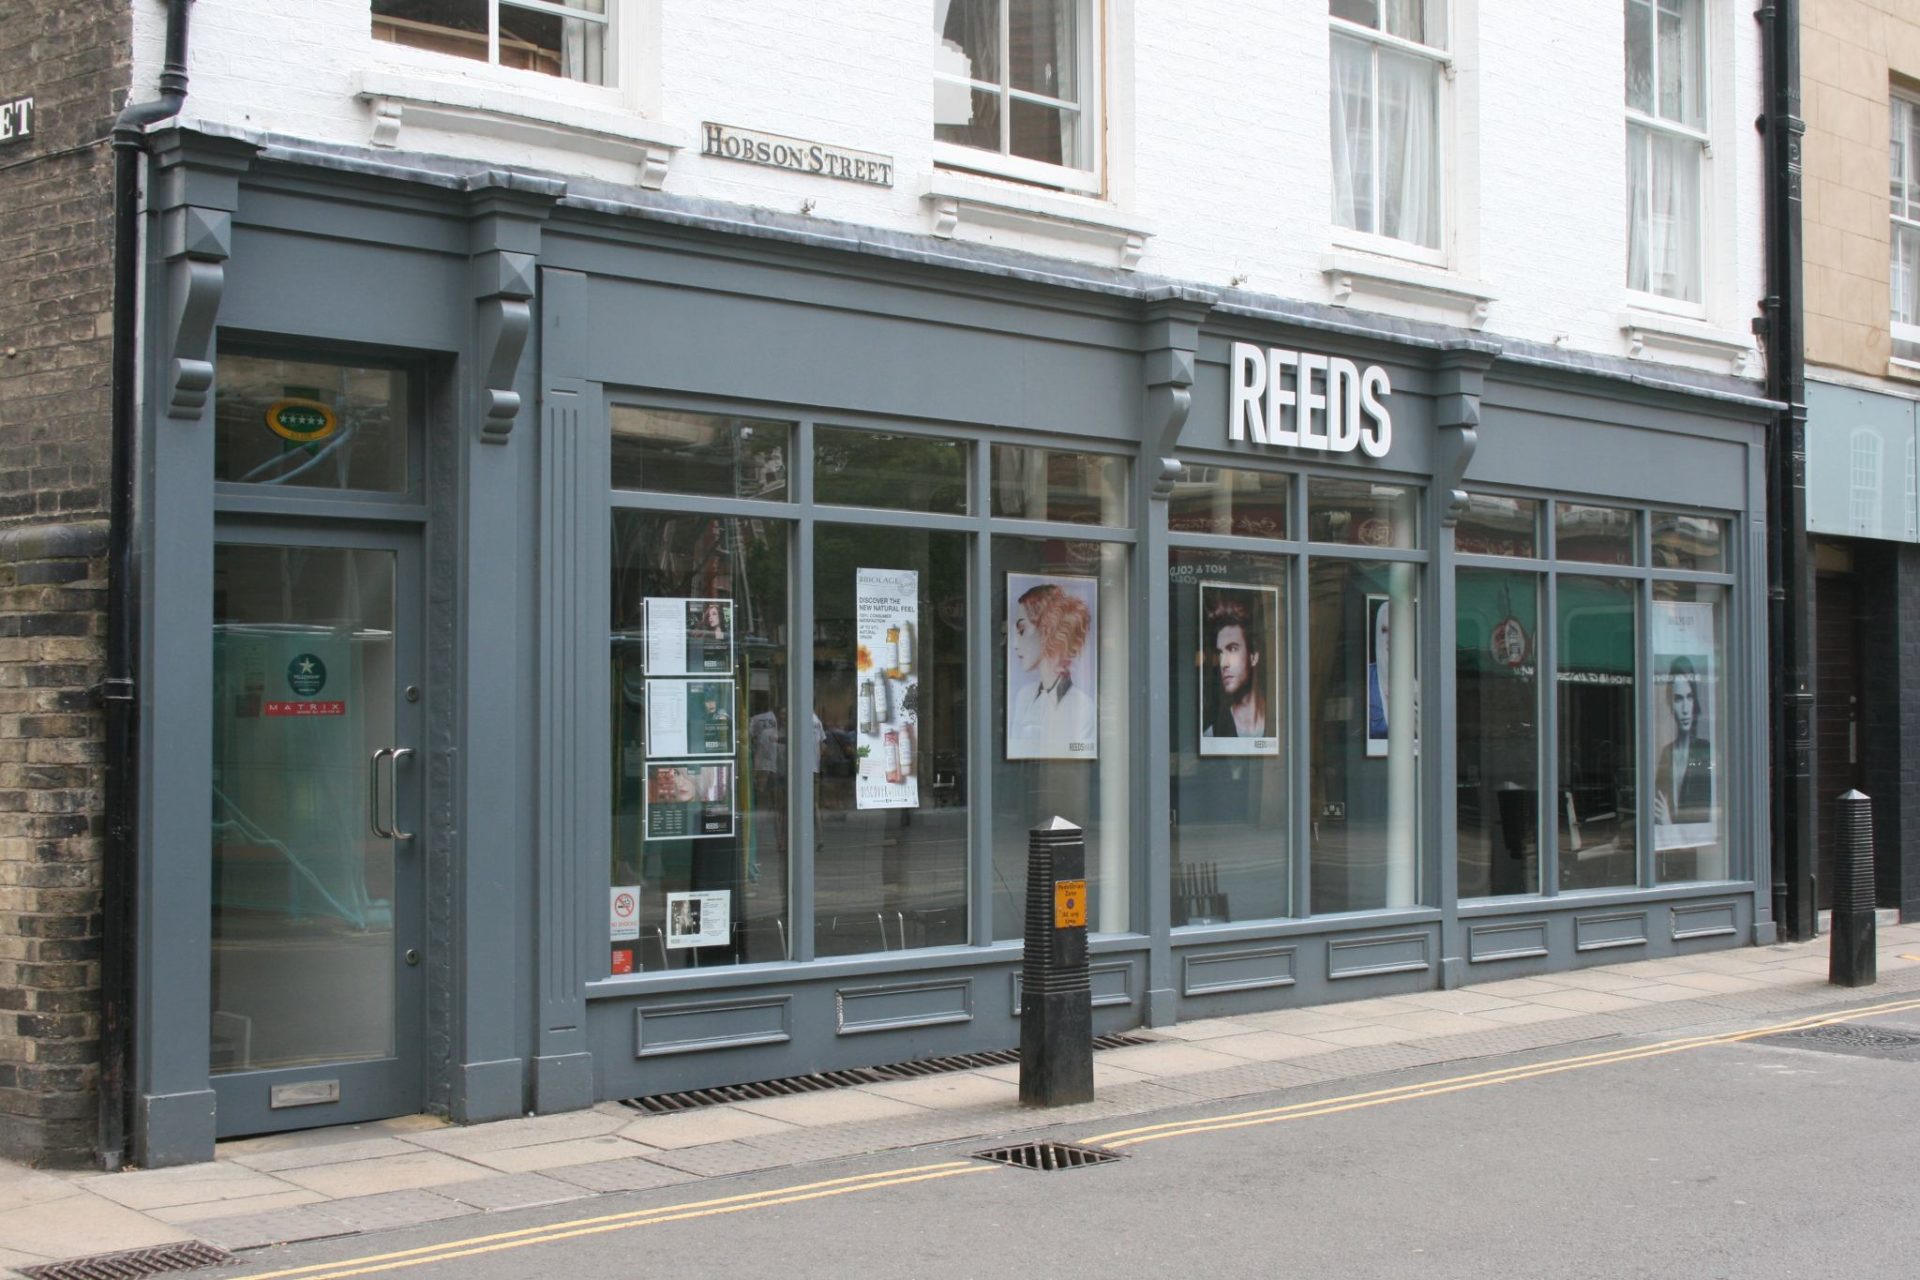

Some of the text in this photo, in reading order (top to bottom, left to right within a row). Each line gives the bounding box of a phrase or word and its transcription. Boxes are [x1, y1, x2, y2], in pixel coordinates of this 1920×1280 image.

[705, 125, 892, 185] HOBSON STREET
[1228, 341, 1393, 459] REEDS
[859, 597, 889, 605] DISCOVER
[269, 703, 340, 711] MATRIX
